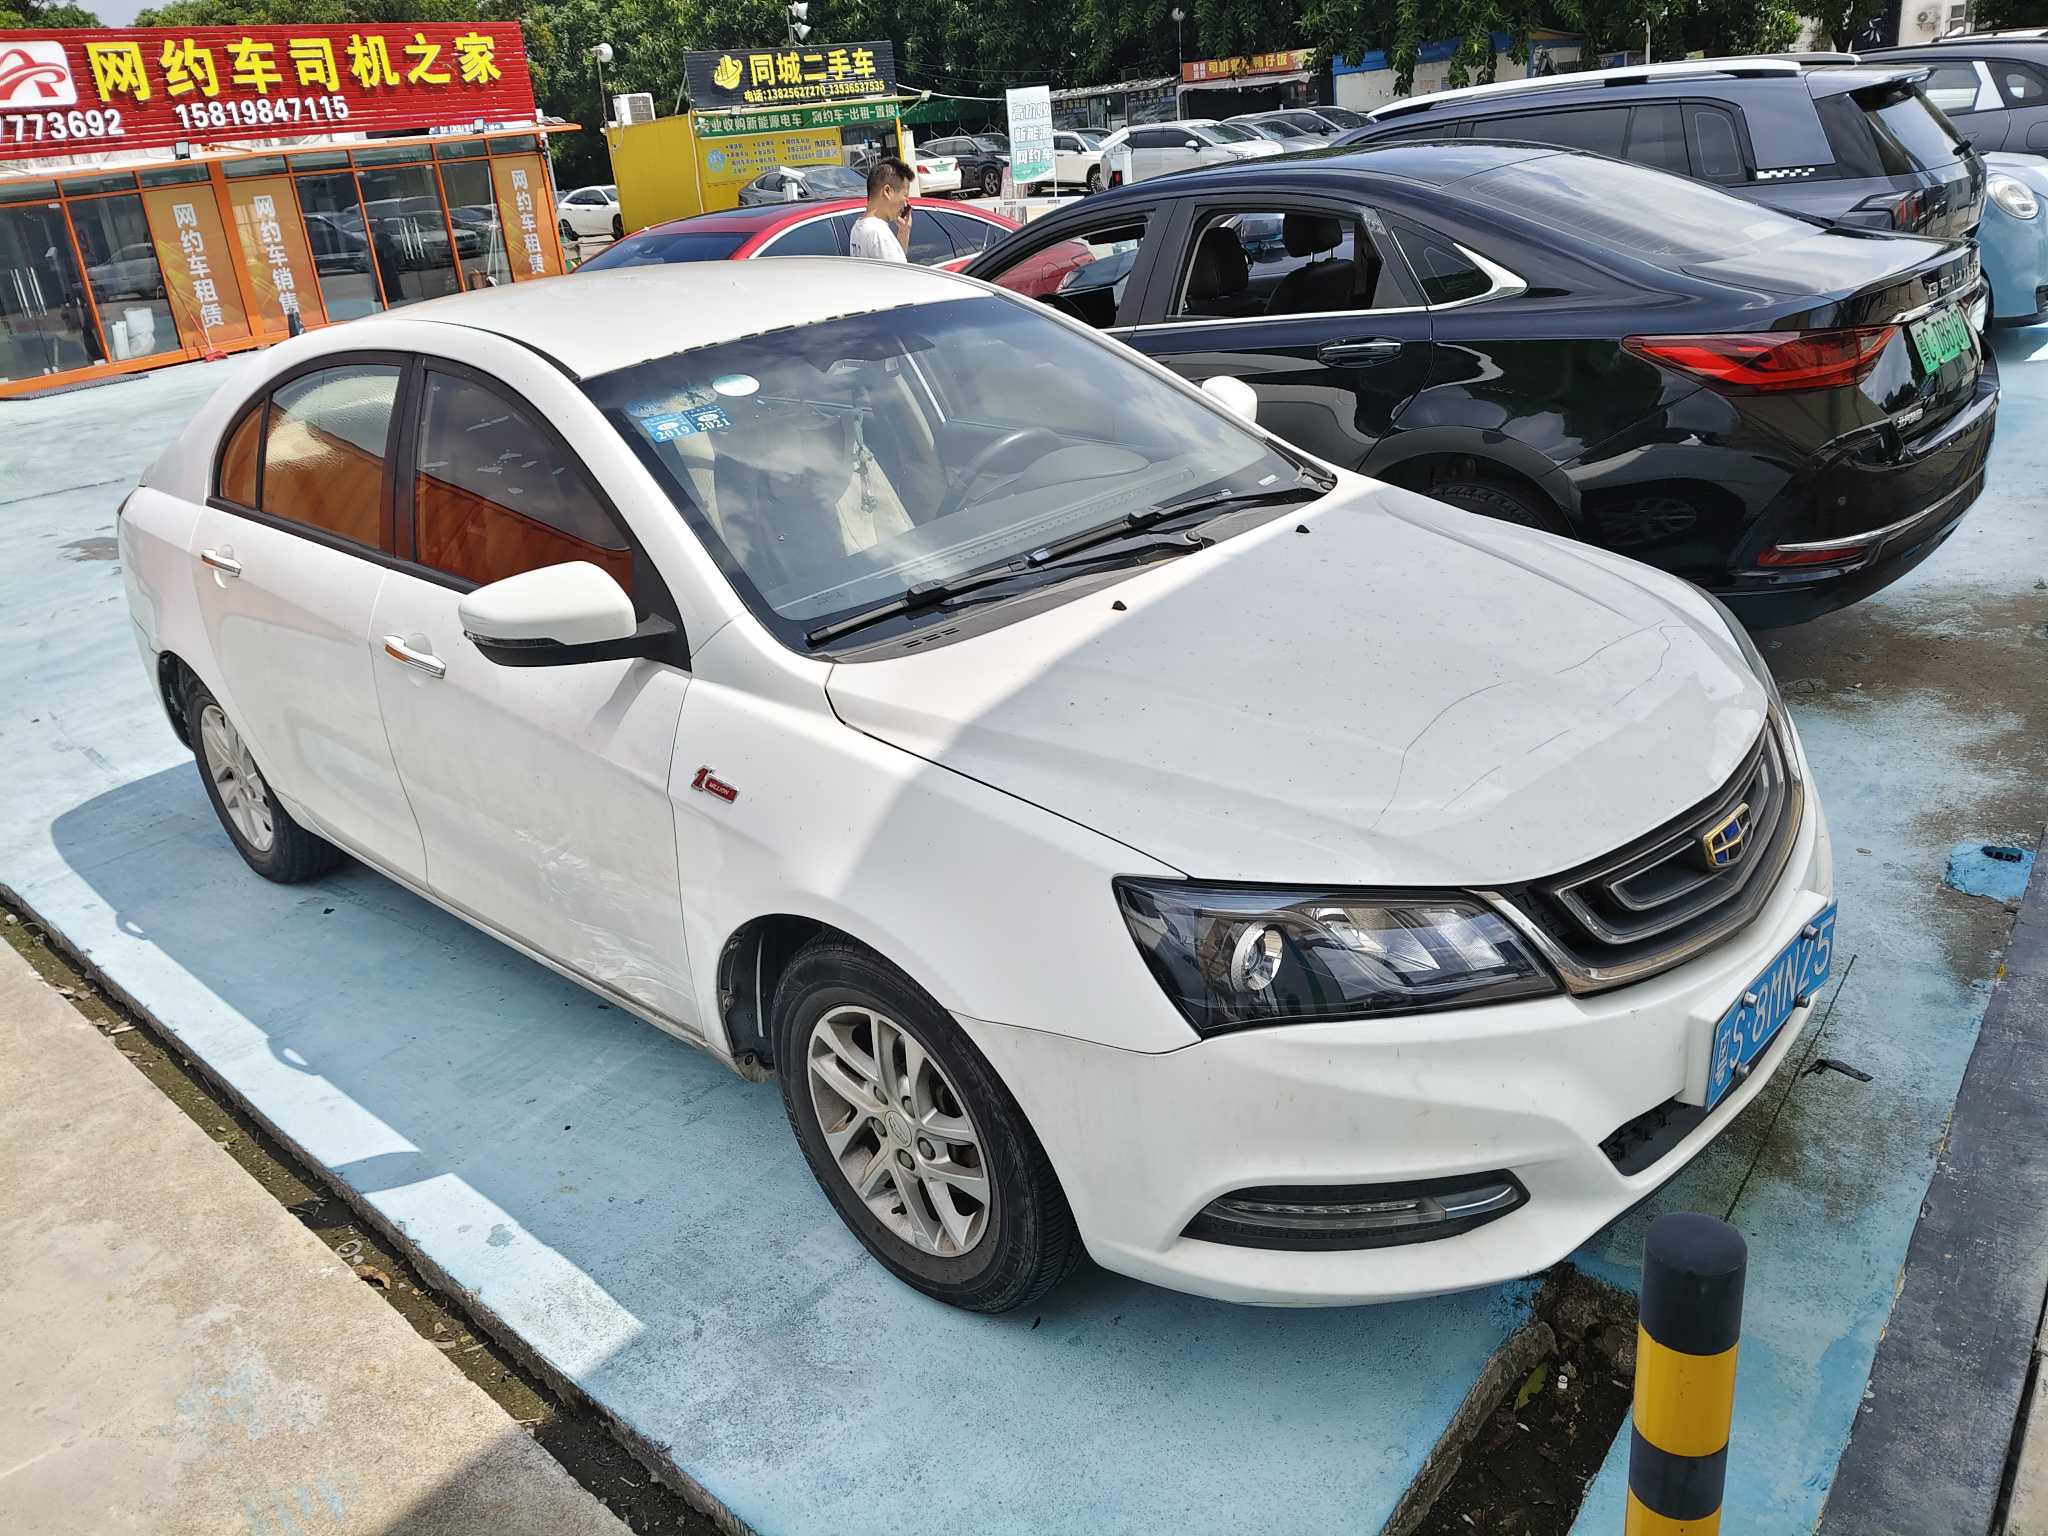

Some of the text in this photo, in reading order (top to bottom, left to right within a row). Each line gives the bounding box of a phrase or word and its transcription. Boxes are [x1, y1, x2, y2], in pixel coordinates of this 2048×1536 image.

[84, 32, 502, 102] 网约车司机之家
[749, 47, 876, 86] 同城二手车
[175, 95, 349, 129] 15819847115
[1011, 102, 1051, 121] 高价收
[1014, 124, 1053, 143] 新能源
[1016, 146, 1054, 165] 网约车
[512, 169, 545, 274] 网约车租赁
[172, 203, 224, 328] 网约车租赁
[253, 195, 301, 316] 网约车销售
[655, 426, 690, 440] 2019
[697, 418, 731, 431] 2021
